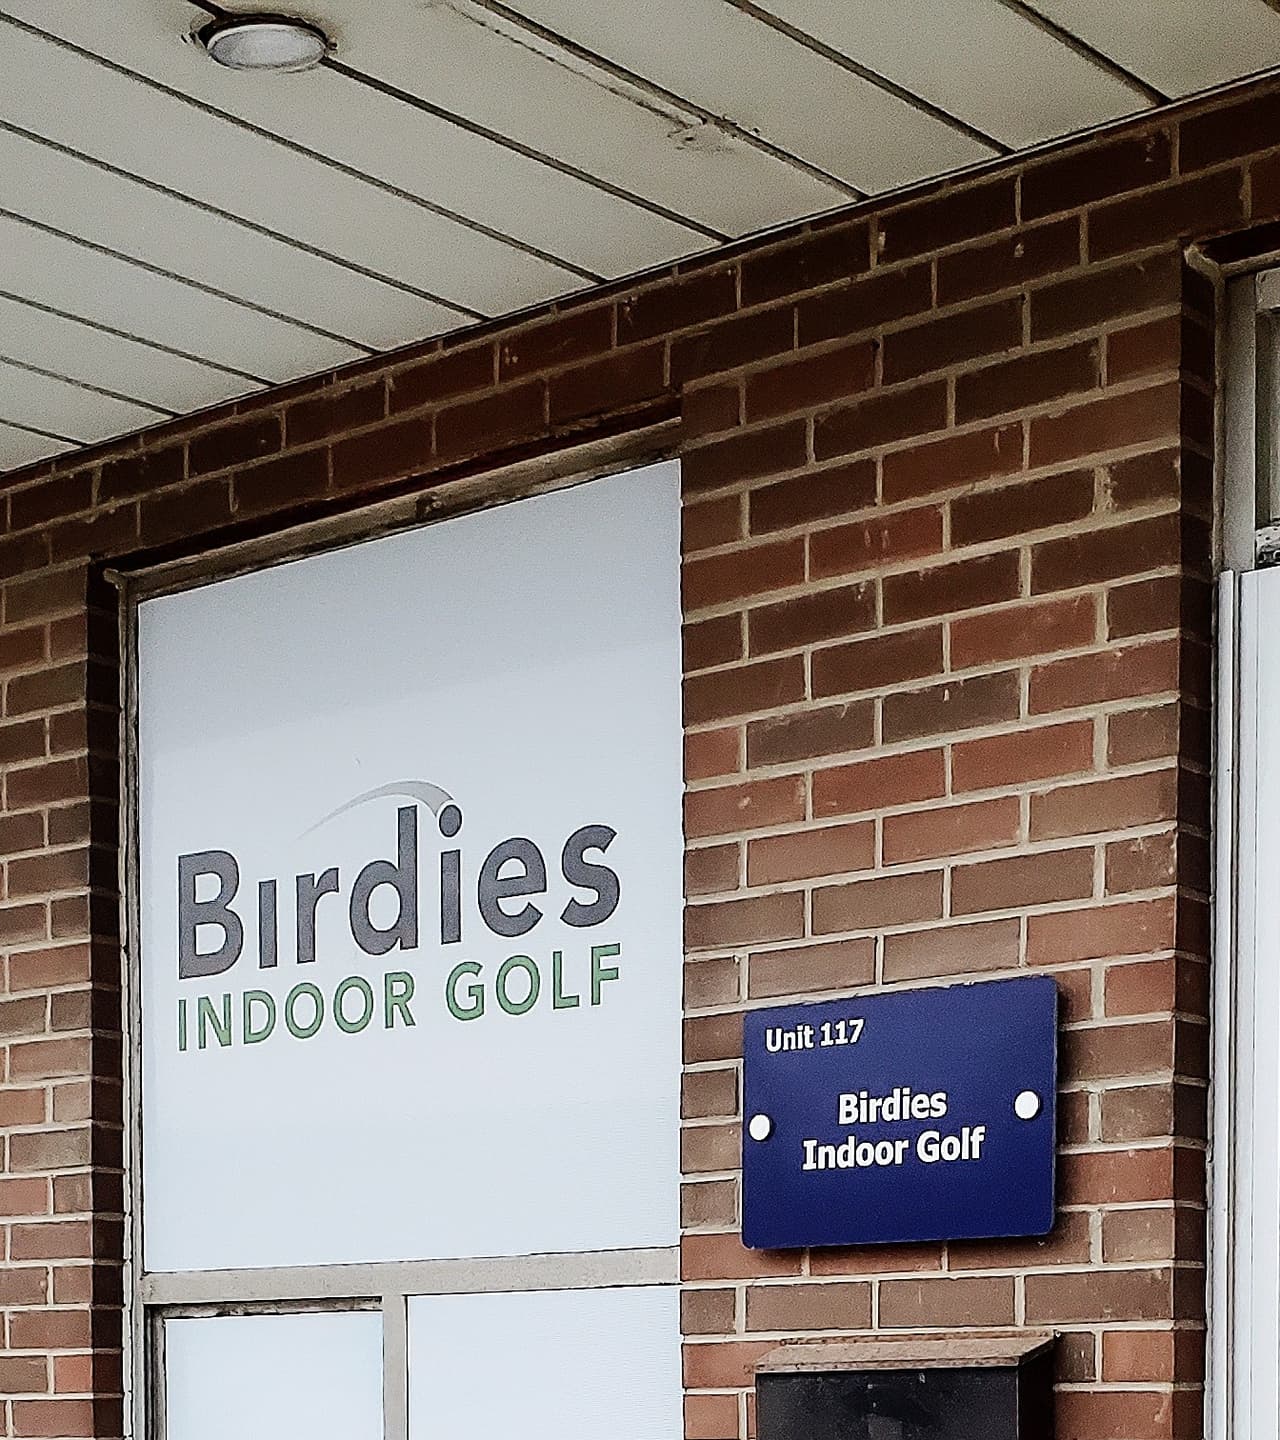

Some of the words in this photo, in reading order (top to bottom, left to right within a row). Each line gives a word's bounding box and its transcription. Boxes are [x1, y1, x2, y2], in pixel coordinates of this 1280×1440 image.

[178, 804, 621, 980] Birdies
[178, 972, 417, 1052] INDOOR
[445, 942, 622, 1022] GOLF
[765, 1023, 813, 1053] Unit
[819, 1019, 865, 1048] 117
[837, 1089, 948, 1126] Birdies
[801, 1134, 908, 1172] Indoor
[917, 1125, 986, 1164] Golf
